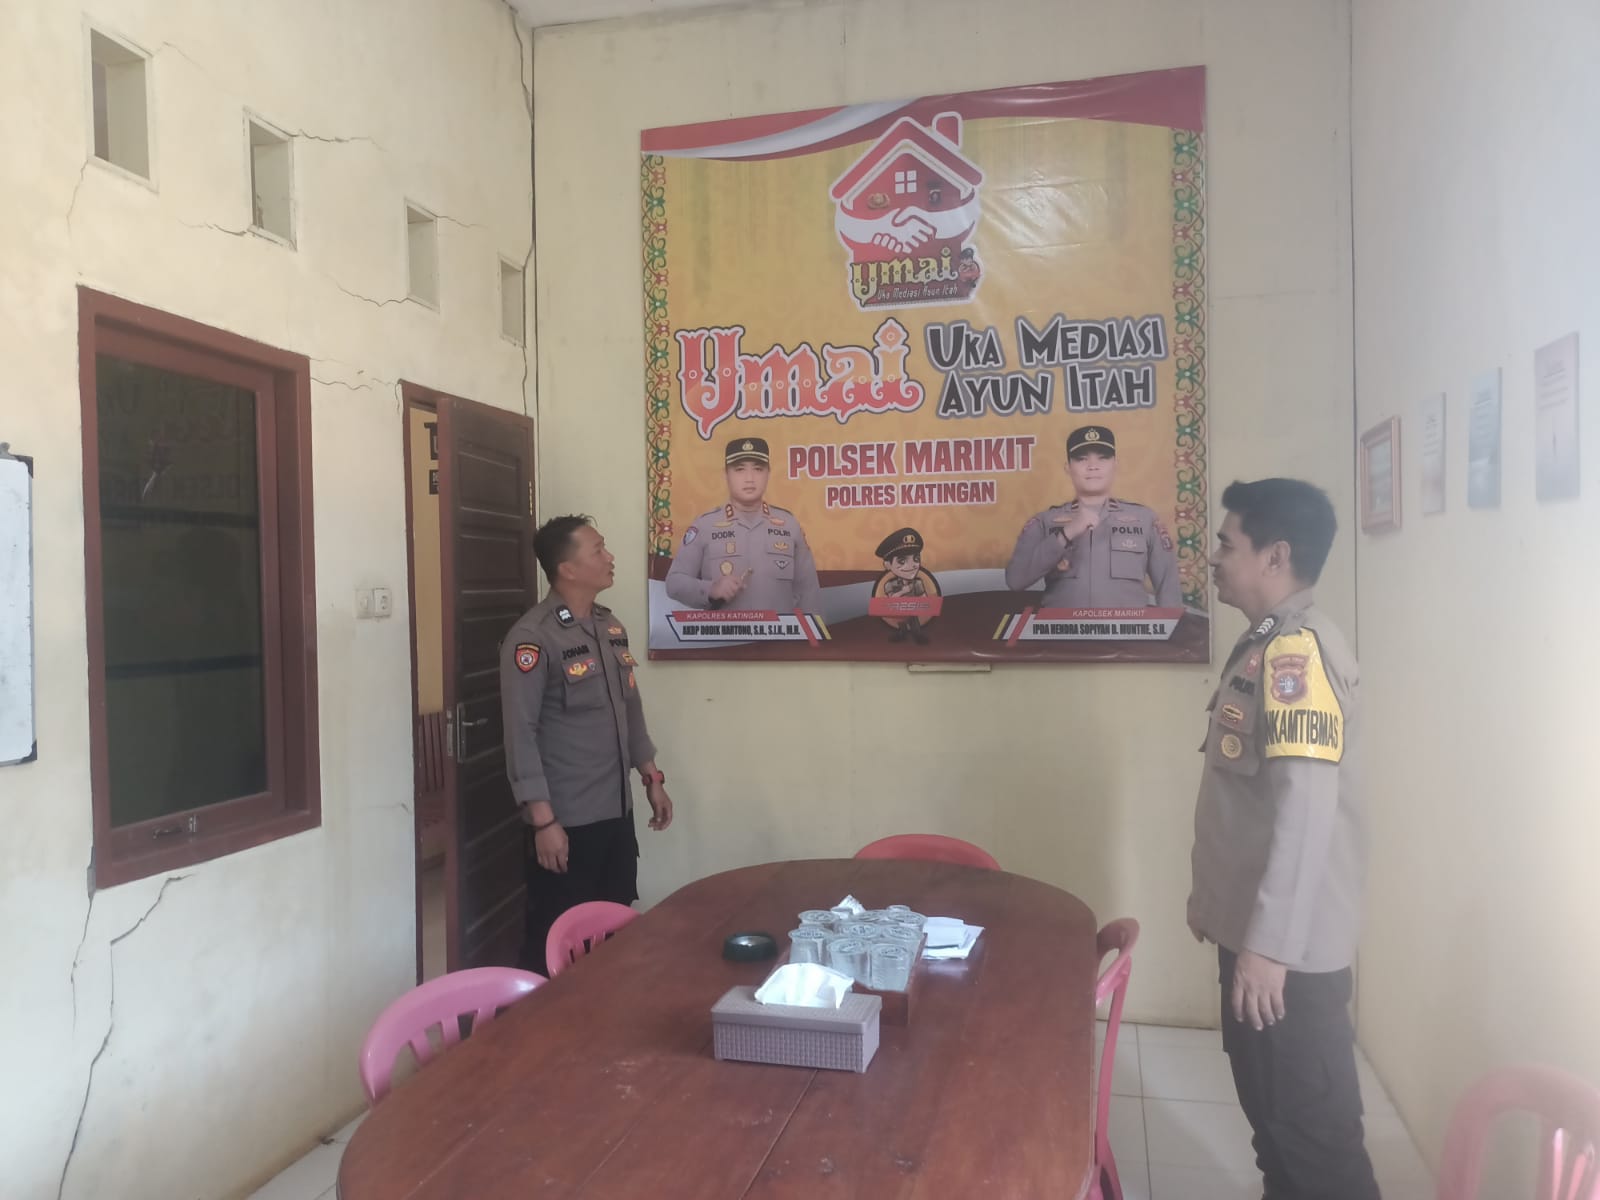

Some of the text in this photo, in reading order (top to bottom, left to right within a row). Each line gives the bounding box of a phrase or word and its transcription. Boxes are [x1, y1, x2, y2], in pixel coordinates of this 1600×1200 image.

[675, 318, 924, 439] Umai
[939, 371, 1051, 416] AYUN
[789, 436, 1036, 478] POLSEK MARIKIT
[827, 480, 996, 508] POLRES KATINGAN
[712, 528, 791, 540] DODIK POLRI
[1111, 526, 1143, 535] POLRI
[687, 611, 764, 620] KAPOLRES KATINGAN
[1114, 609, 1146, 617] MARIKIT
[682, 625, 700, 636] AKBP
[701, 625, 721, 636] DODIK
[1033, 623, 1050, 635] IPDA
[1050, 623, 1079, 635] HENDRA
